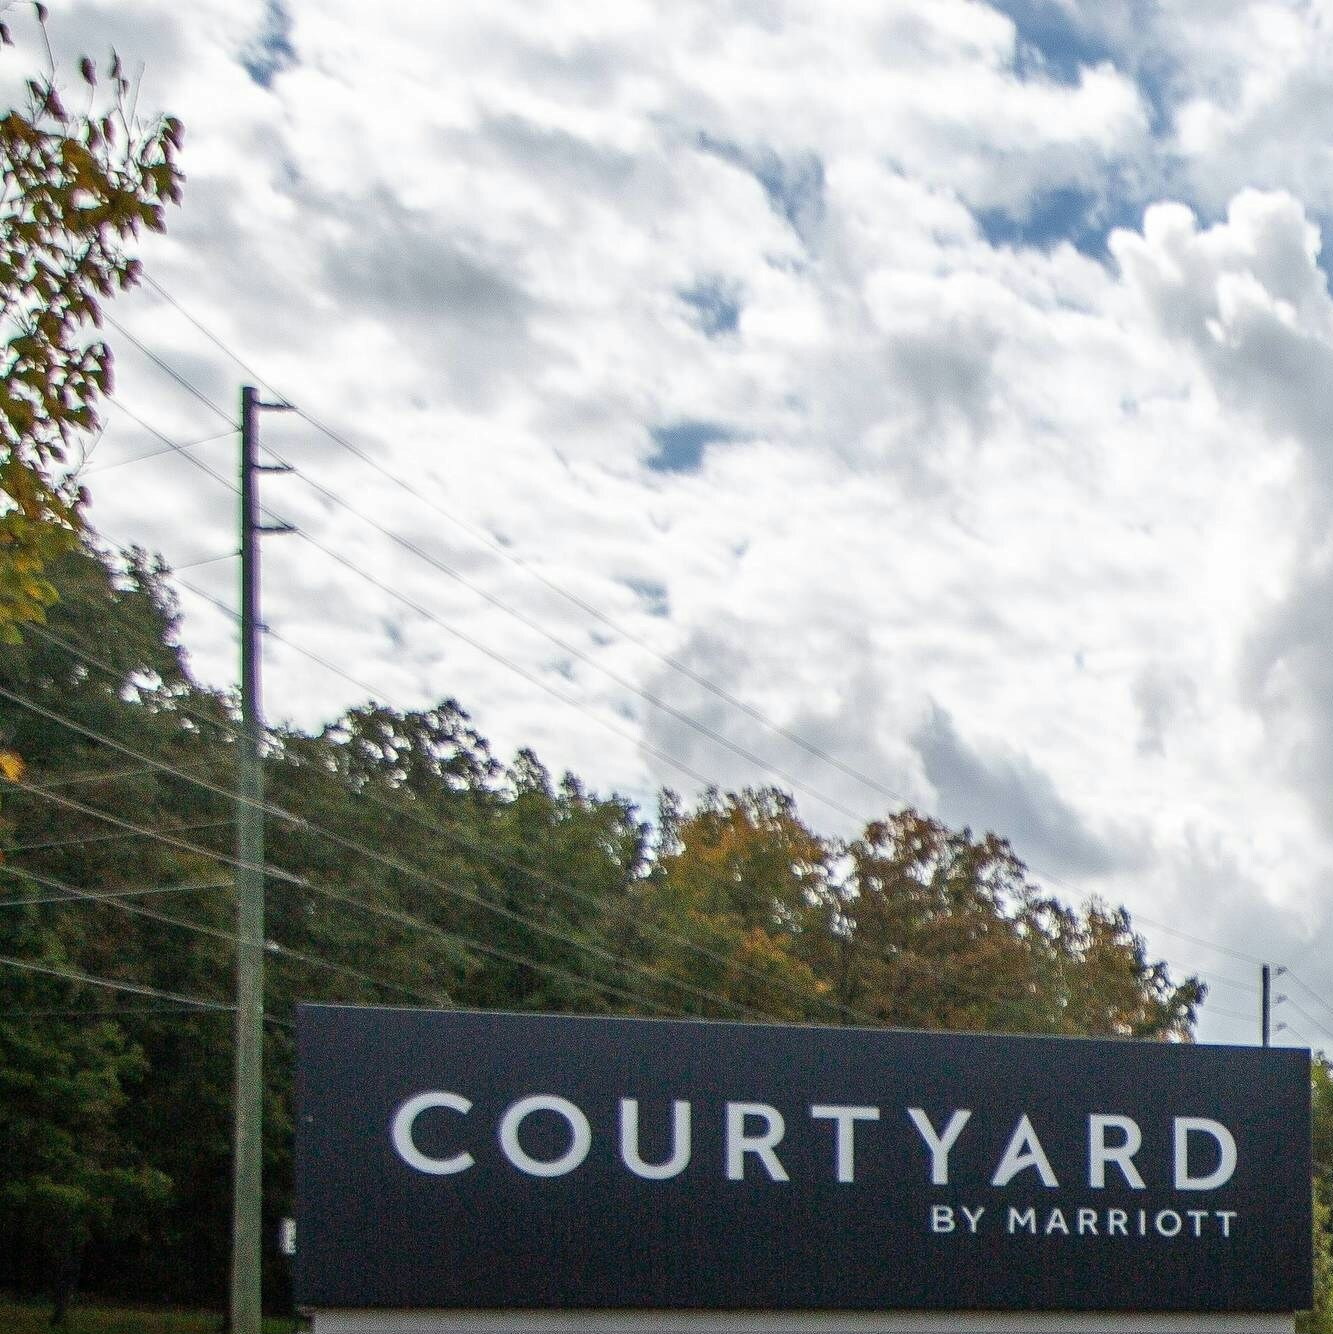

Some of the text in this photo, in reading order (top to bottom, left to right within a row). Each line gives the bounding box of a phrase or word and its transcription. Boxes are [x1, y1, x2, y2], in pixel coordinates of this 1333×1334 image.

[390, 1089, 1238, 1191] COURTYARD
[931, 1204, 1238, 1237] BY MARRIOTT
